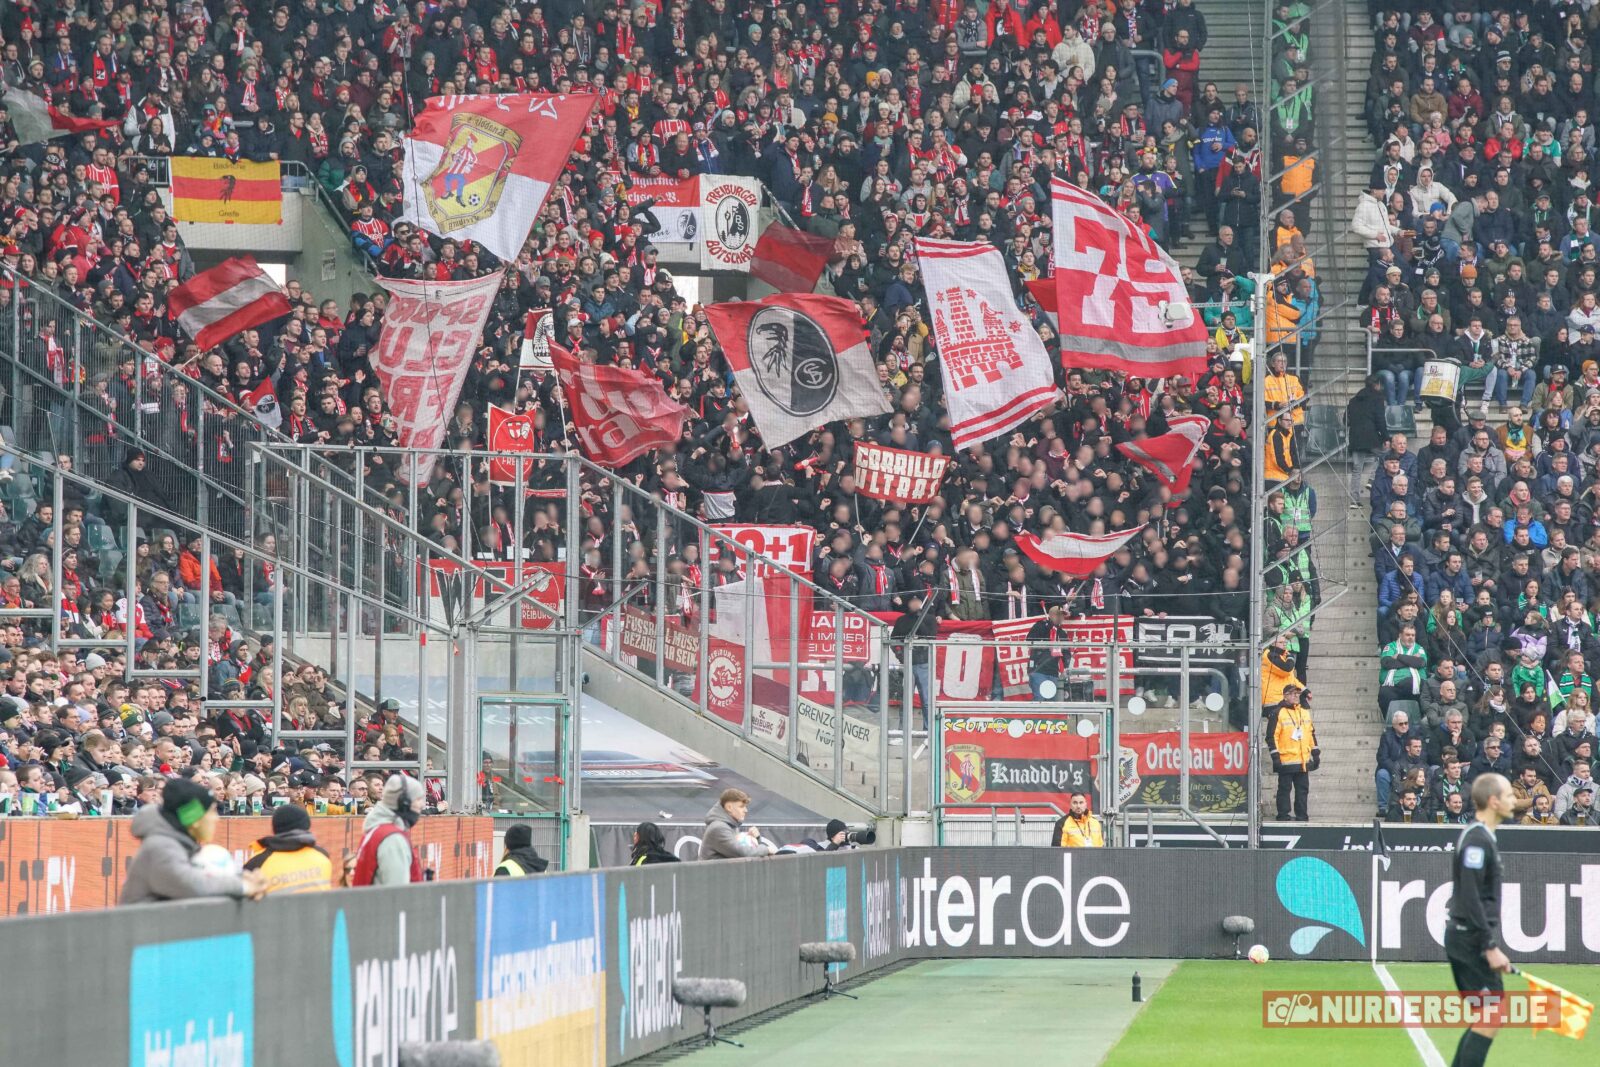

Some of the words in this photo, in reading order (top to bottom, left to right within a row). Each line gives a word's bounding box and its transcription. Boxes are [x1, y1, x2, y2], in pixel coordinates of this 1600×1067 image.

[705, 184, 757, 206] FREIBURGER
[856, 446, 946, 479] CORRILLO
[855, 466, 938, 499] ULTRAS
[626, 614, 671, 643] FUSSBL
[624, 631, 676, 660] BEZAHLAR
[1219, 741, 1244, 770] '90
[990, 762, 1084, 790] Knaddly's
